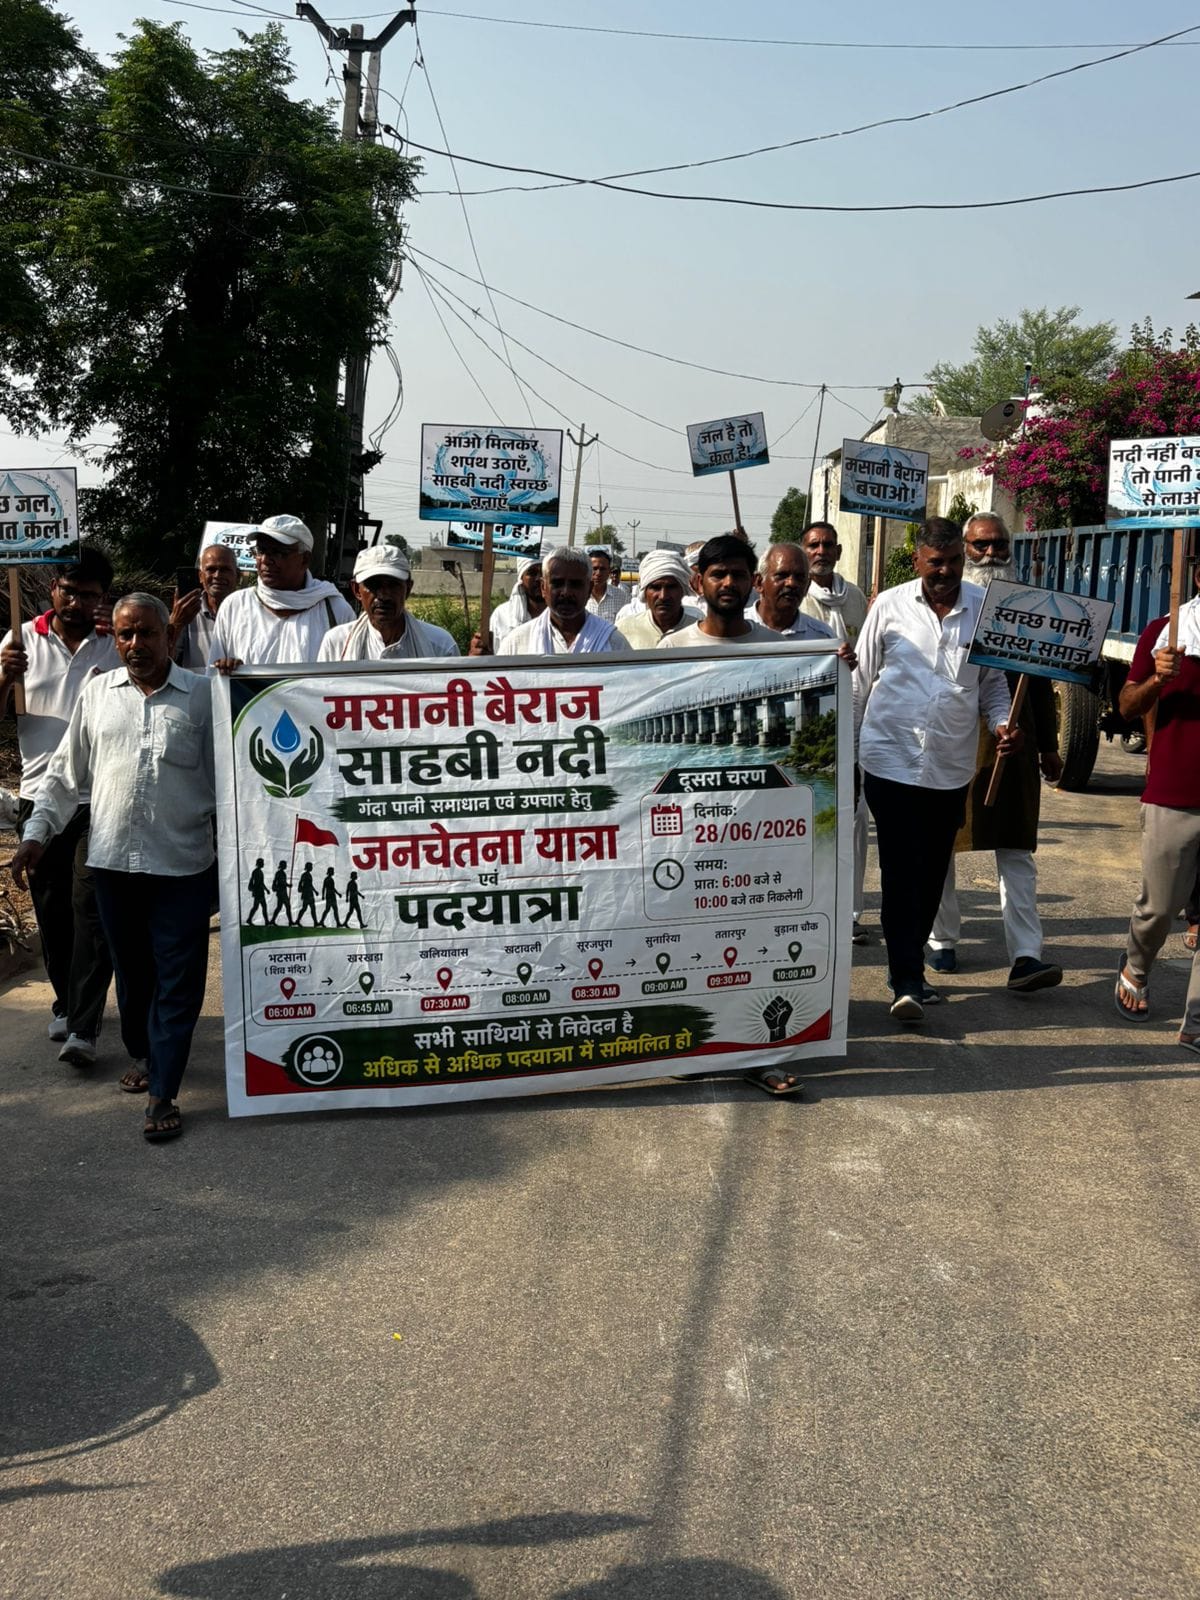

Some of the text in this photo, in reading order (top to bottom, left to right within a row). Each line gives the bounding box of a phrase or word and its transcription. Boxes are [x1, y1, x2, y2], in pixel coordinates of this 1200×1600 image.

[700, 420, 752, 444] जल है तो
[444, 434, 539, 451] आओ मिलकर
[1112, 444, 1142, 462] नदी
[1146, 442, 1179, 462] नहीं
[450, 456, 530, 472] शपथ उठाएँ,
[709, 448, 734, 463] कल
[845, 458, 926, 484] मसानी बैराज
[1132, 466, 1150, 484] तो
[1154, 464, 1192, 482] पानी
[432, 472, 548, 491] साहबी नदी स्वच्छ
[470, 493, 508, 509] बनाएँ
[855, 480, 916, 504] बचाओ!
[1142, 488, 1157, 506] से
[14, 495, 56, 516] जल,
[23, 518, 69, 539] कल!
[994, 606, 1093, 641] स्वच्छ पानी,
[984, 630, 1092, 664] स्वस्थ समाज
[324, 676, 603, 731] मसानी बैराज
[336, 724, 610, 786] साहबी नदी
[678, 768, 766, 793] दूसरा चरण
[358, 788, 592, 816] गंदा पानी समाधान एवं उपचार हेतु
[694, 802, 737, 819] दिनांक:
[694, 818, 806, 844] 28/06/2026
[350, 823, 620, 872] जनचेतना यात्रा
[694, 860, 728, 872] समय:
[478, 871, 500, 886] एवं
[722, 874, 751, 888] 6:00
[754, 872, 770, 886] बजे
[772, 872, 782, 884] से
[395, 886, 583, 930] पदयात्रा
[694, 888, 803, 910] 10:00 बजे तक निकलेगी
[710, 974, 748, 986] 09:30 AM
[776, 968, 813, 980] 10:00 AM
[575, 987, 617, 998] 08:30 AM
[645, 980, 684, 992] 09:00 AM
[346, 1002, 389, 1014] 06:45 AM
[424, 999, 467, 1009] 07:30 AM
[506, 992, 547, 1004] 08:00 AM
[269, 1006, 312, 1017] 06:00 AM
[414, 1010, 634, 1050] सभी साथियों से निवेदन है
[363, 1056, 419, 1078] अधिक
[423, 1053, 441, 1074] से
[446, 1050, 502, 1072] अधिक
[507, 1046, 574, 1067] पदयात्रा
[580, 1040, 594, 1060] में
[599, 1033, 672, 1058] सम्मिलित
